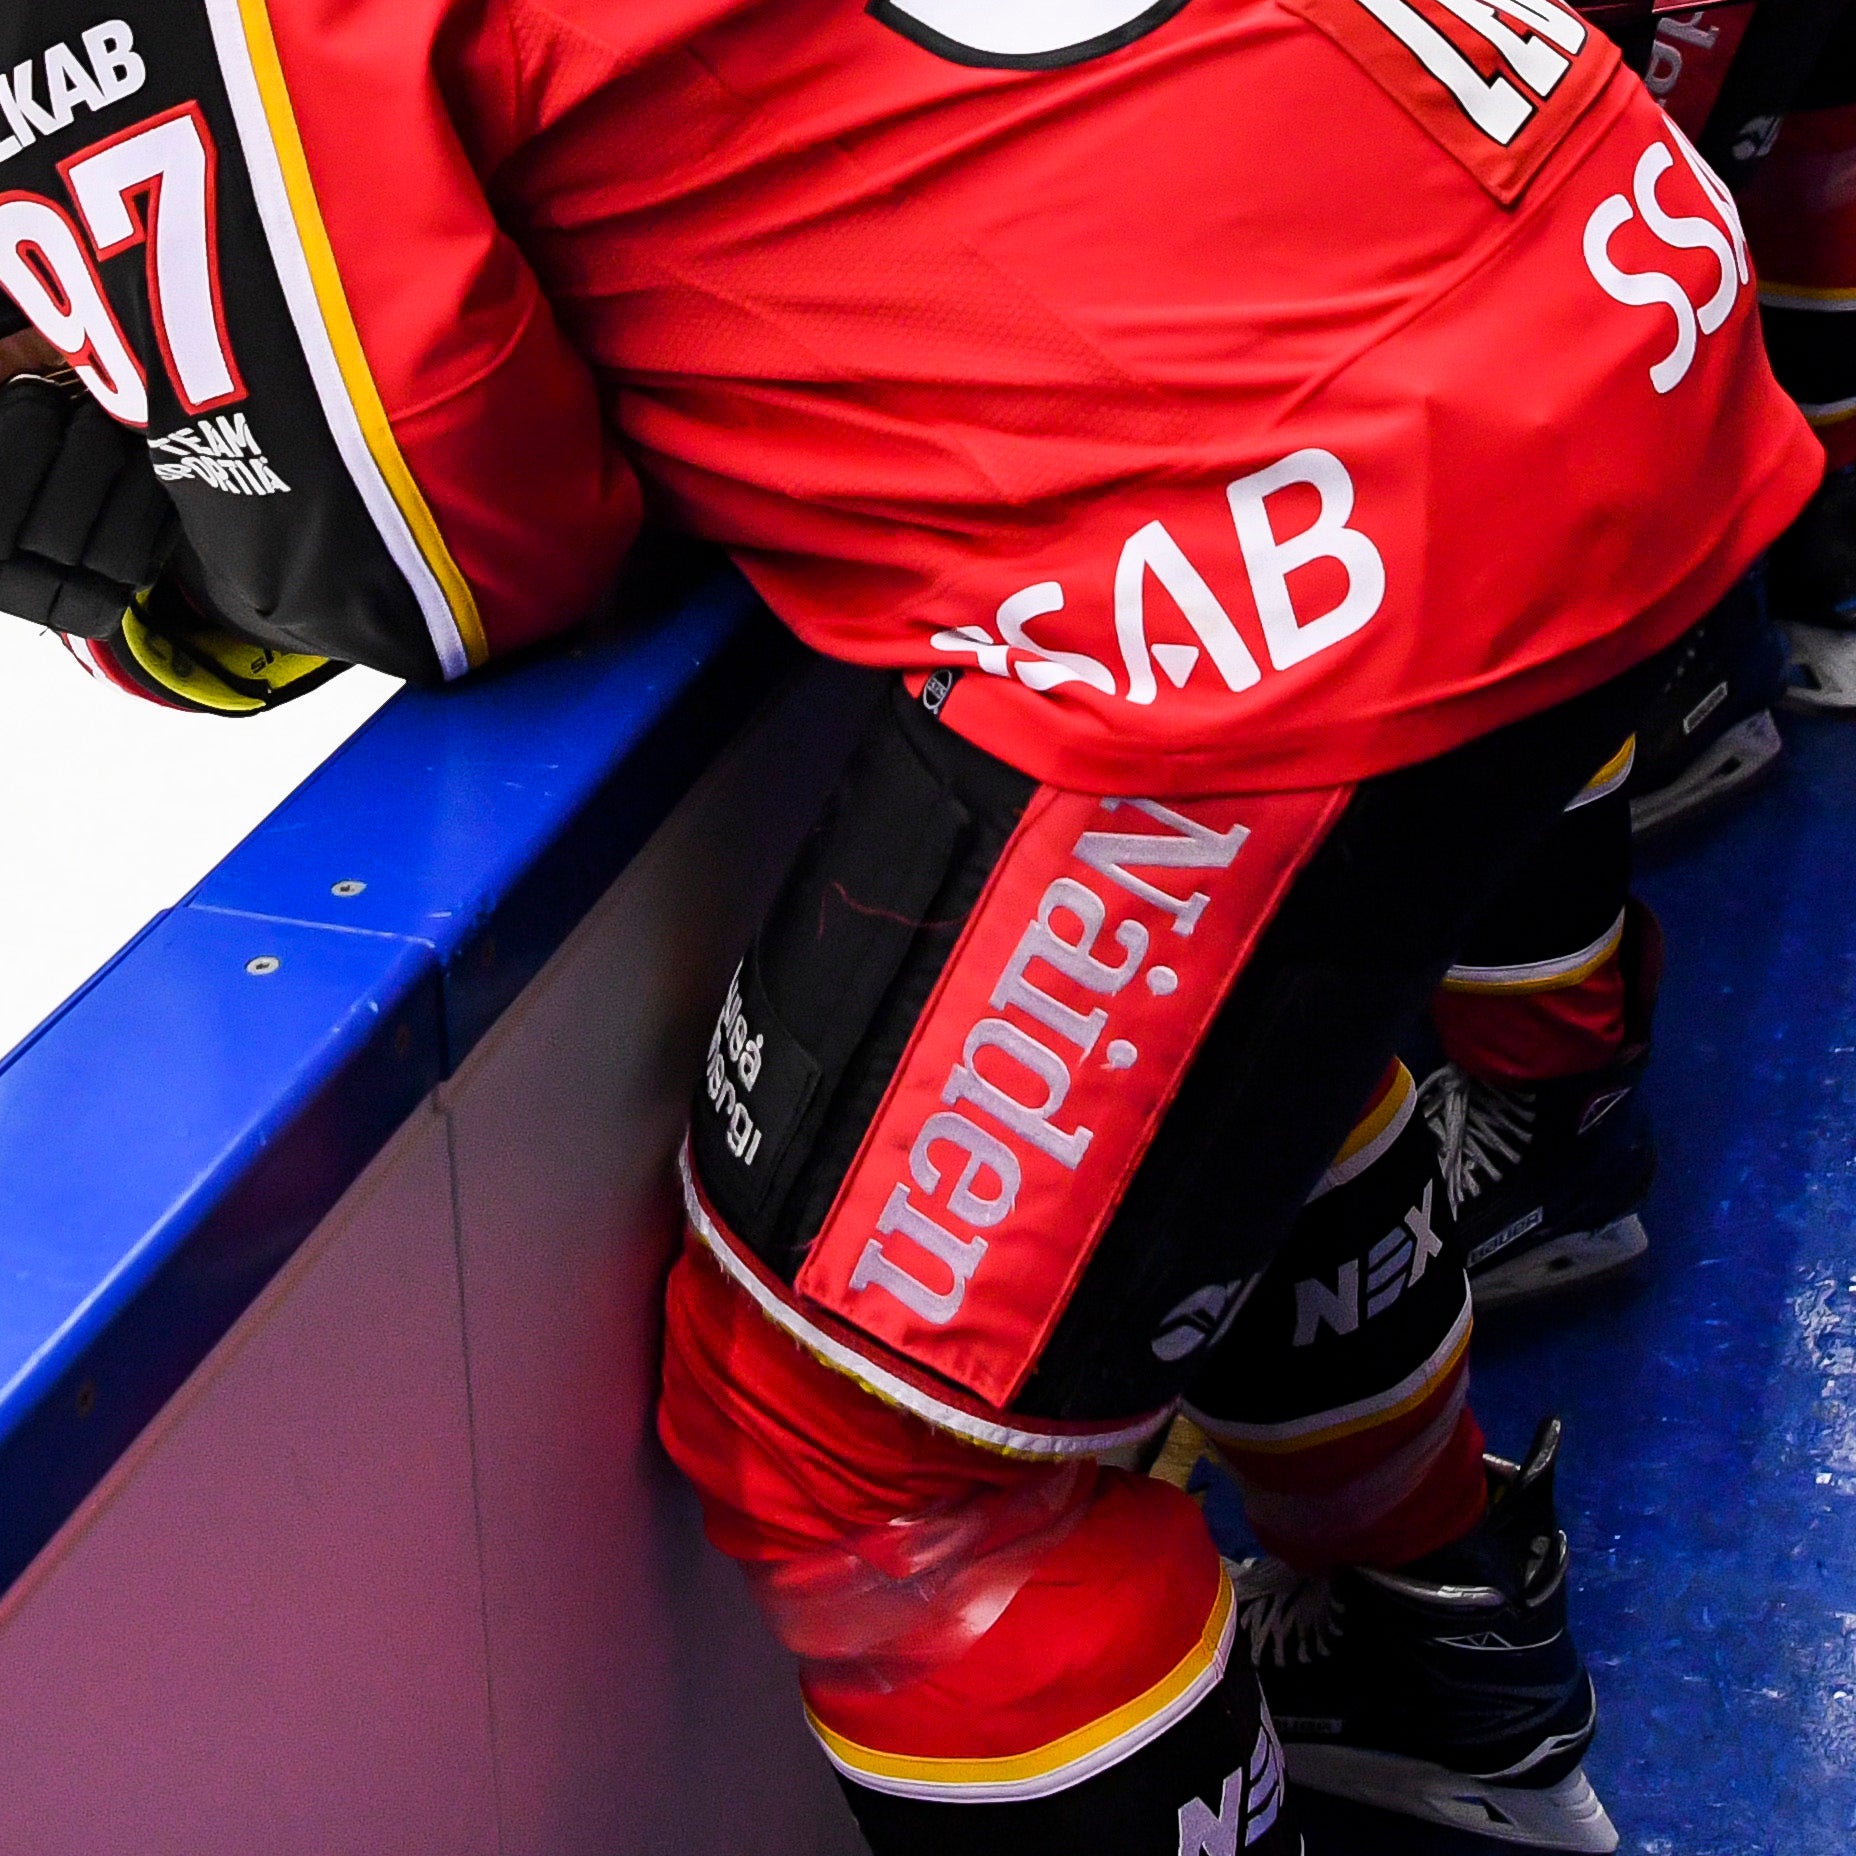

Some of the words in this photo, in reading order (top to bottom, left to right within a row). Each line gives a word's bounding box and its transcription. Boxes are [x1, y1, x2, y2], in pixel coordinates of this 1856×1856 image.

[146, 412, 263, 459] TEAM
[848, 796, 1251, 1328] Nåiden
[1291, 1177, 1443, 1347] NEX
